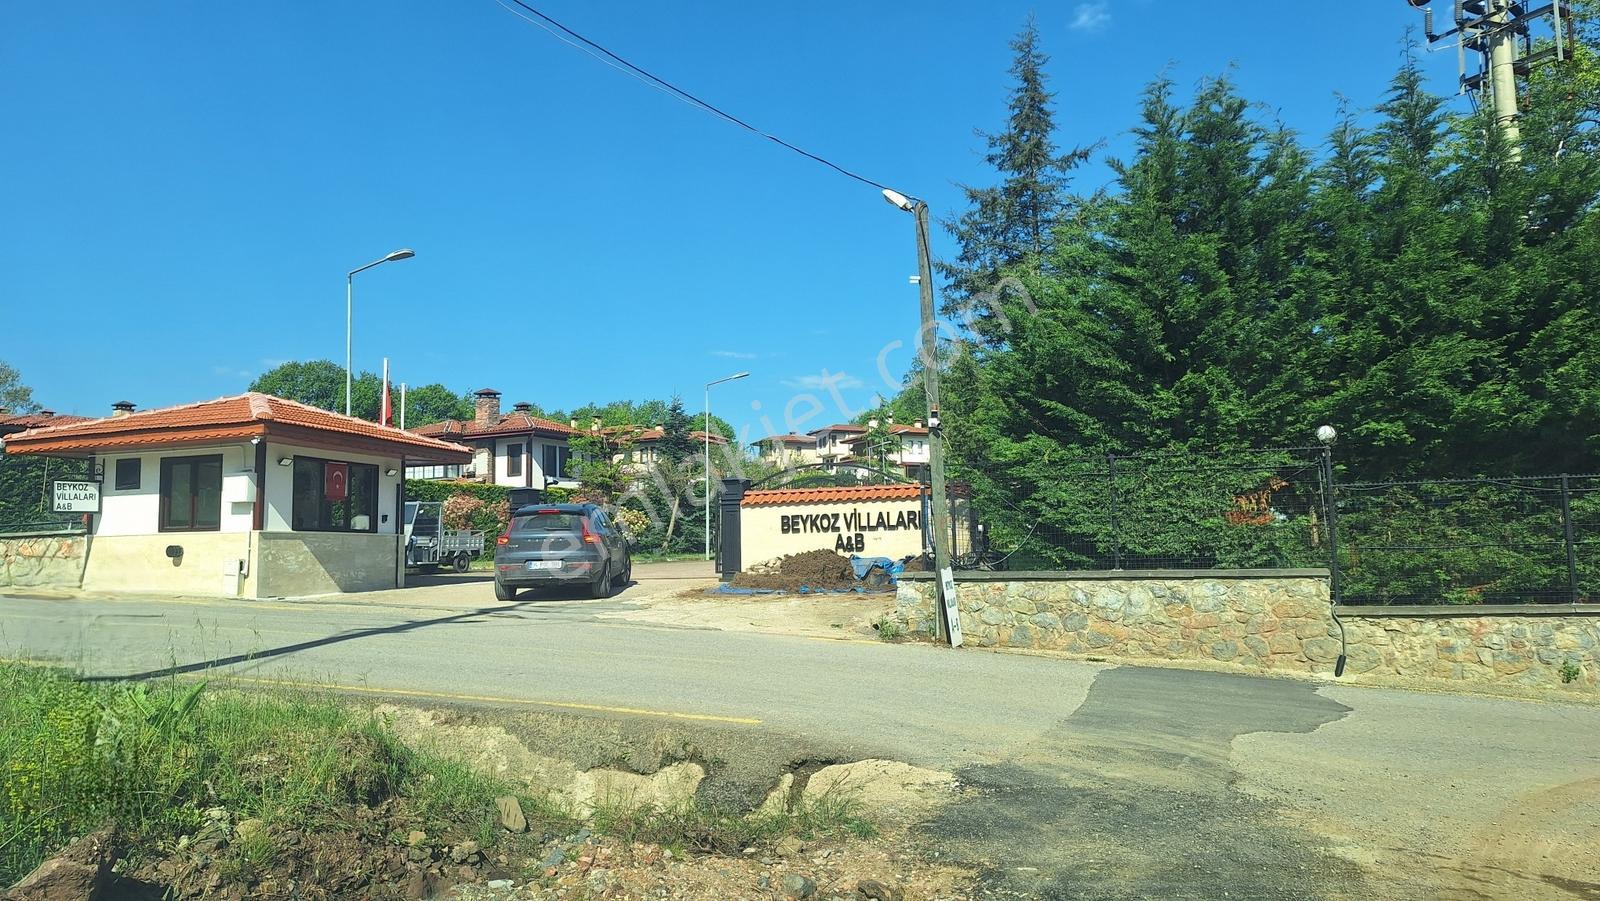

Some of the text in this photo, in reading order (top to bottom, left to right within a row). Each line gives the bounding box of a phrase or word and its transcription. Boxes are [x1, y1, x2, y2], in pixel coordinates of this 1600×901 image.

[57, 483, 88, 491] BEYKOZ
[781, 513, 840, 534] BEYKOZ
[835, 533, 865, 552] A&B
